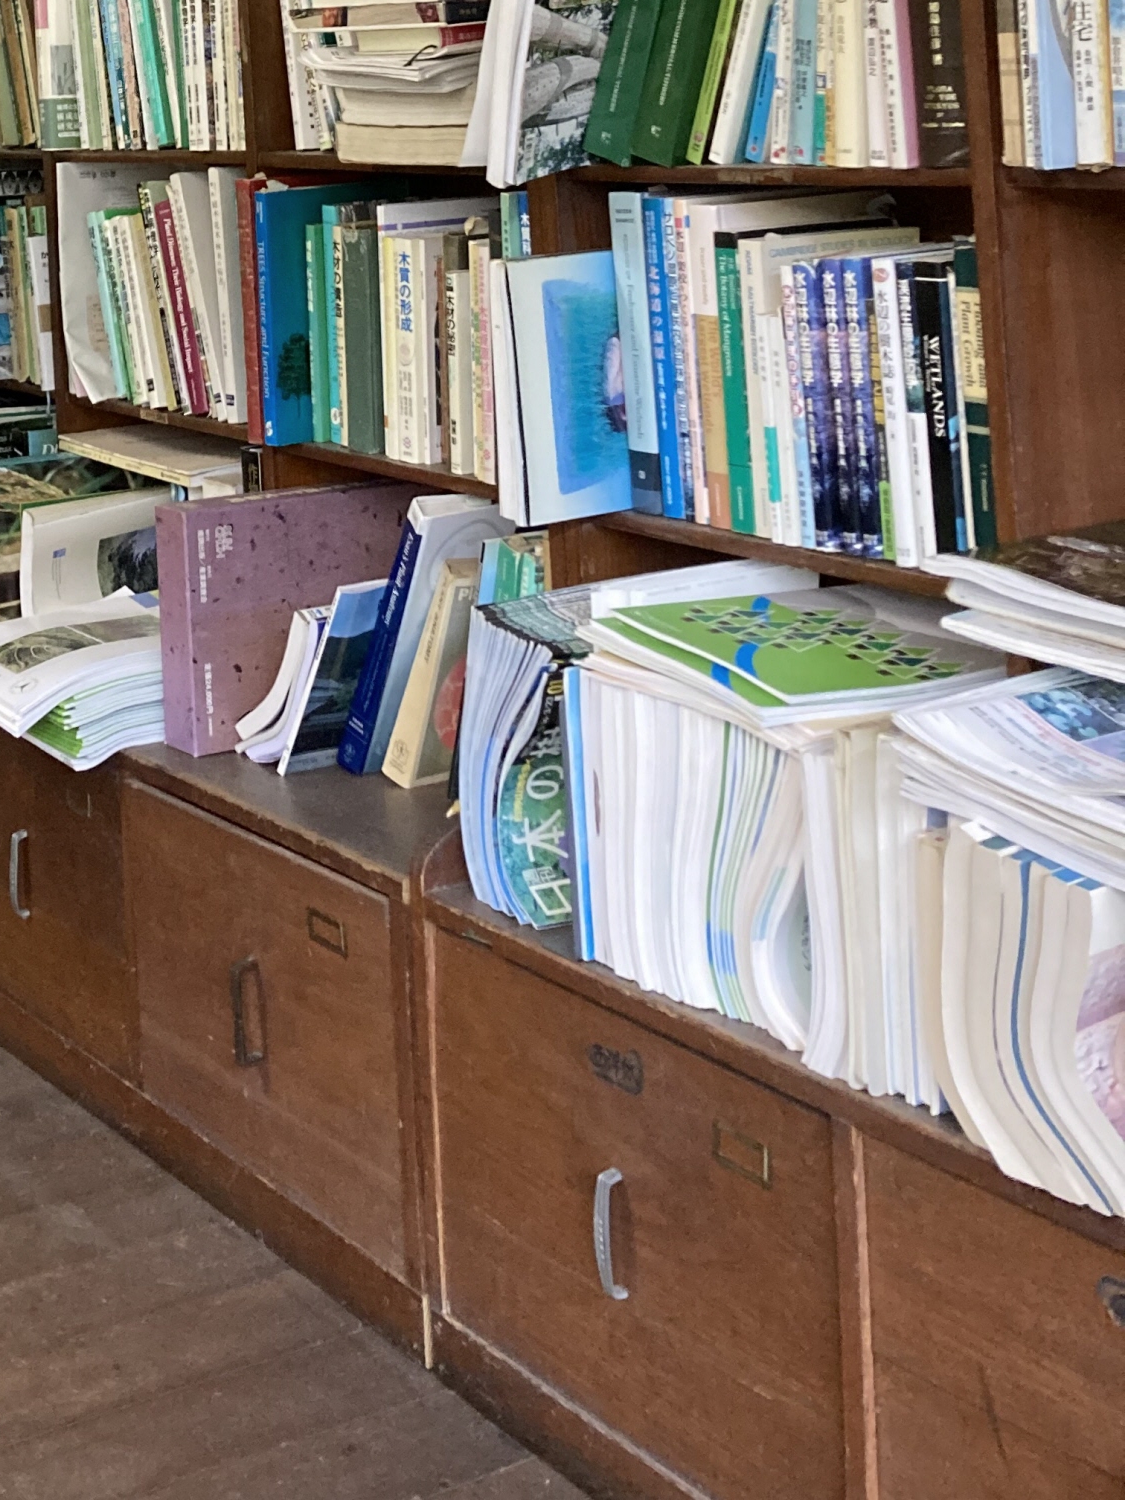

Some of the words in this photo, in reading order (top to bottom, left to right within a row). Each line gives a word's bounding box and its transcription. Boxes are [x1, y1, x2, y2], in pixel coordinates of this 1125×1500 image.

[257, 241, 265, 274] TREES
[718, 255, 727, 273] The
[259, 275, 268, 322] Structure
[398, 250, 413, 333] 木質の形成
[719, 275, 730, 311] Botany
[961, 300, 971, 335] Plant
[723, 322, 733, 377] Mangroves
[963, 339, 976, 387] Growth
[262, 351, 271, 399] Function
[928, 336, 947, 438] WETLANDS
[383, 589, 402, 628] Anatomy
